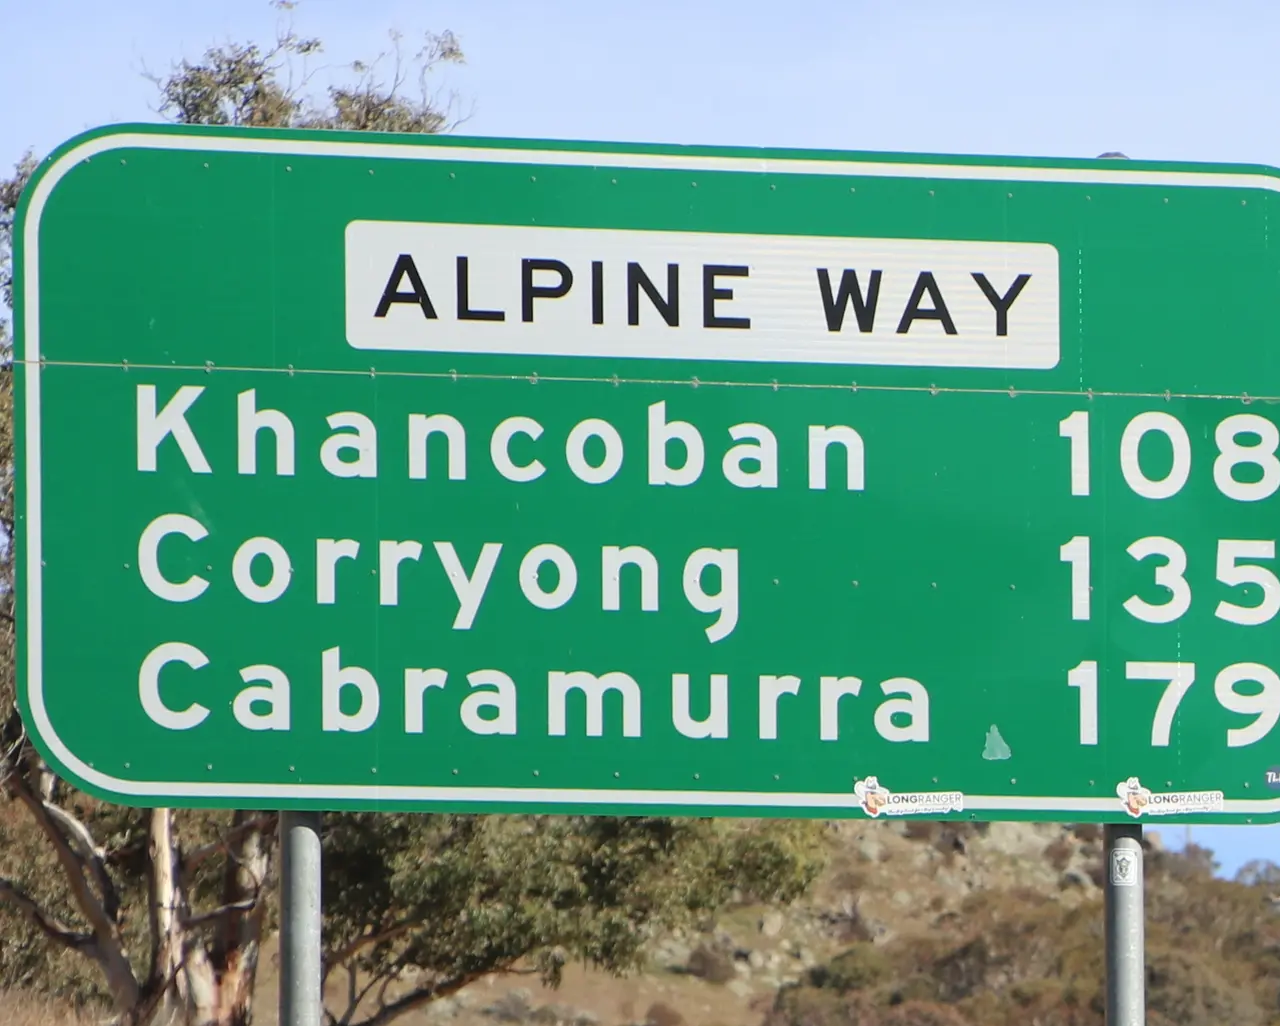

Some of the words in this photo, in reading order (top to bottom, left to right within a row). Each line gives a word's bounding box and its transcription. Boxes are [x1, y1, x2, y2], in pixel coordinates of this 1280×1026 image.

[374, 253, 752, 330] ALPINE
[815, 267, 1032, 337] WAY
[135, 383, 866, 491] Khancoban
[136, 512, 740, 644] Corryong
[137, 641, 931, 743] Cabramurra
